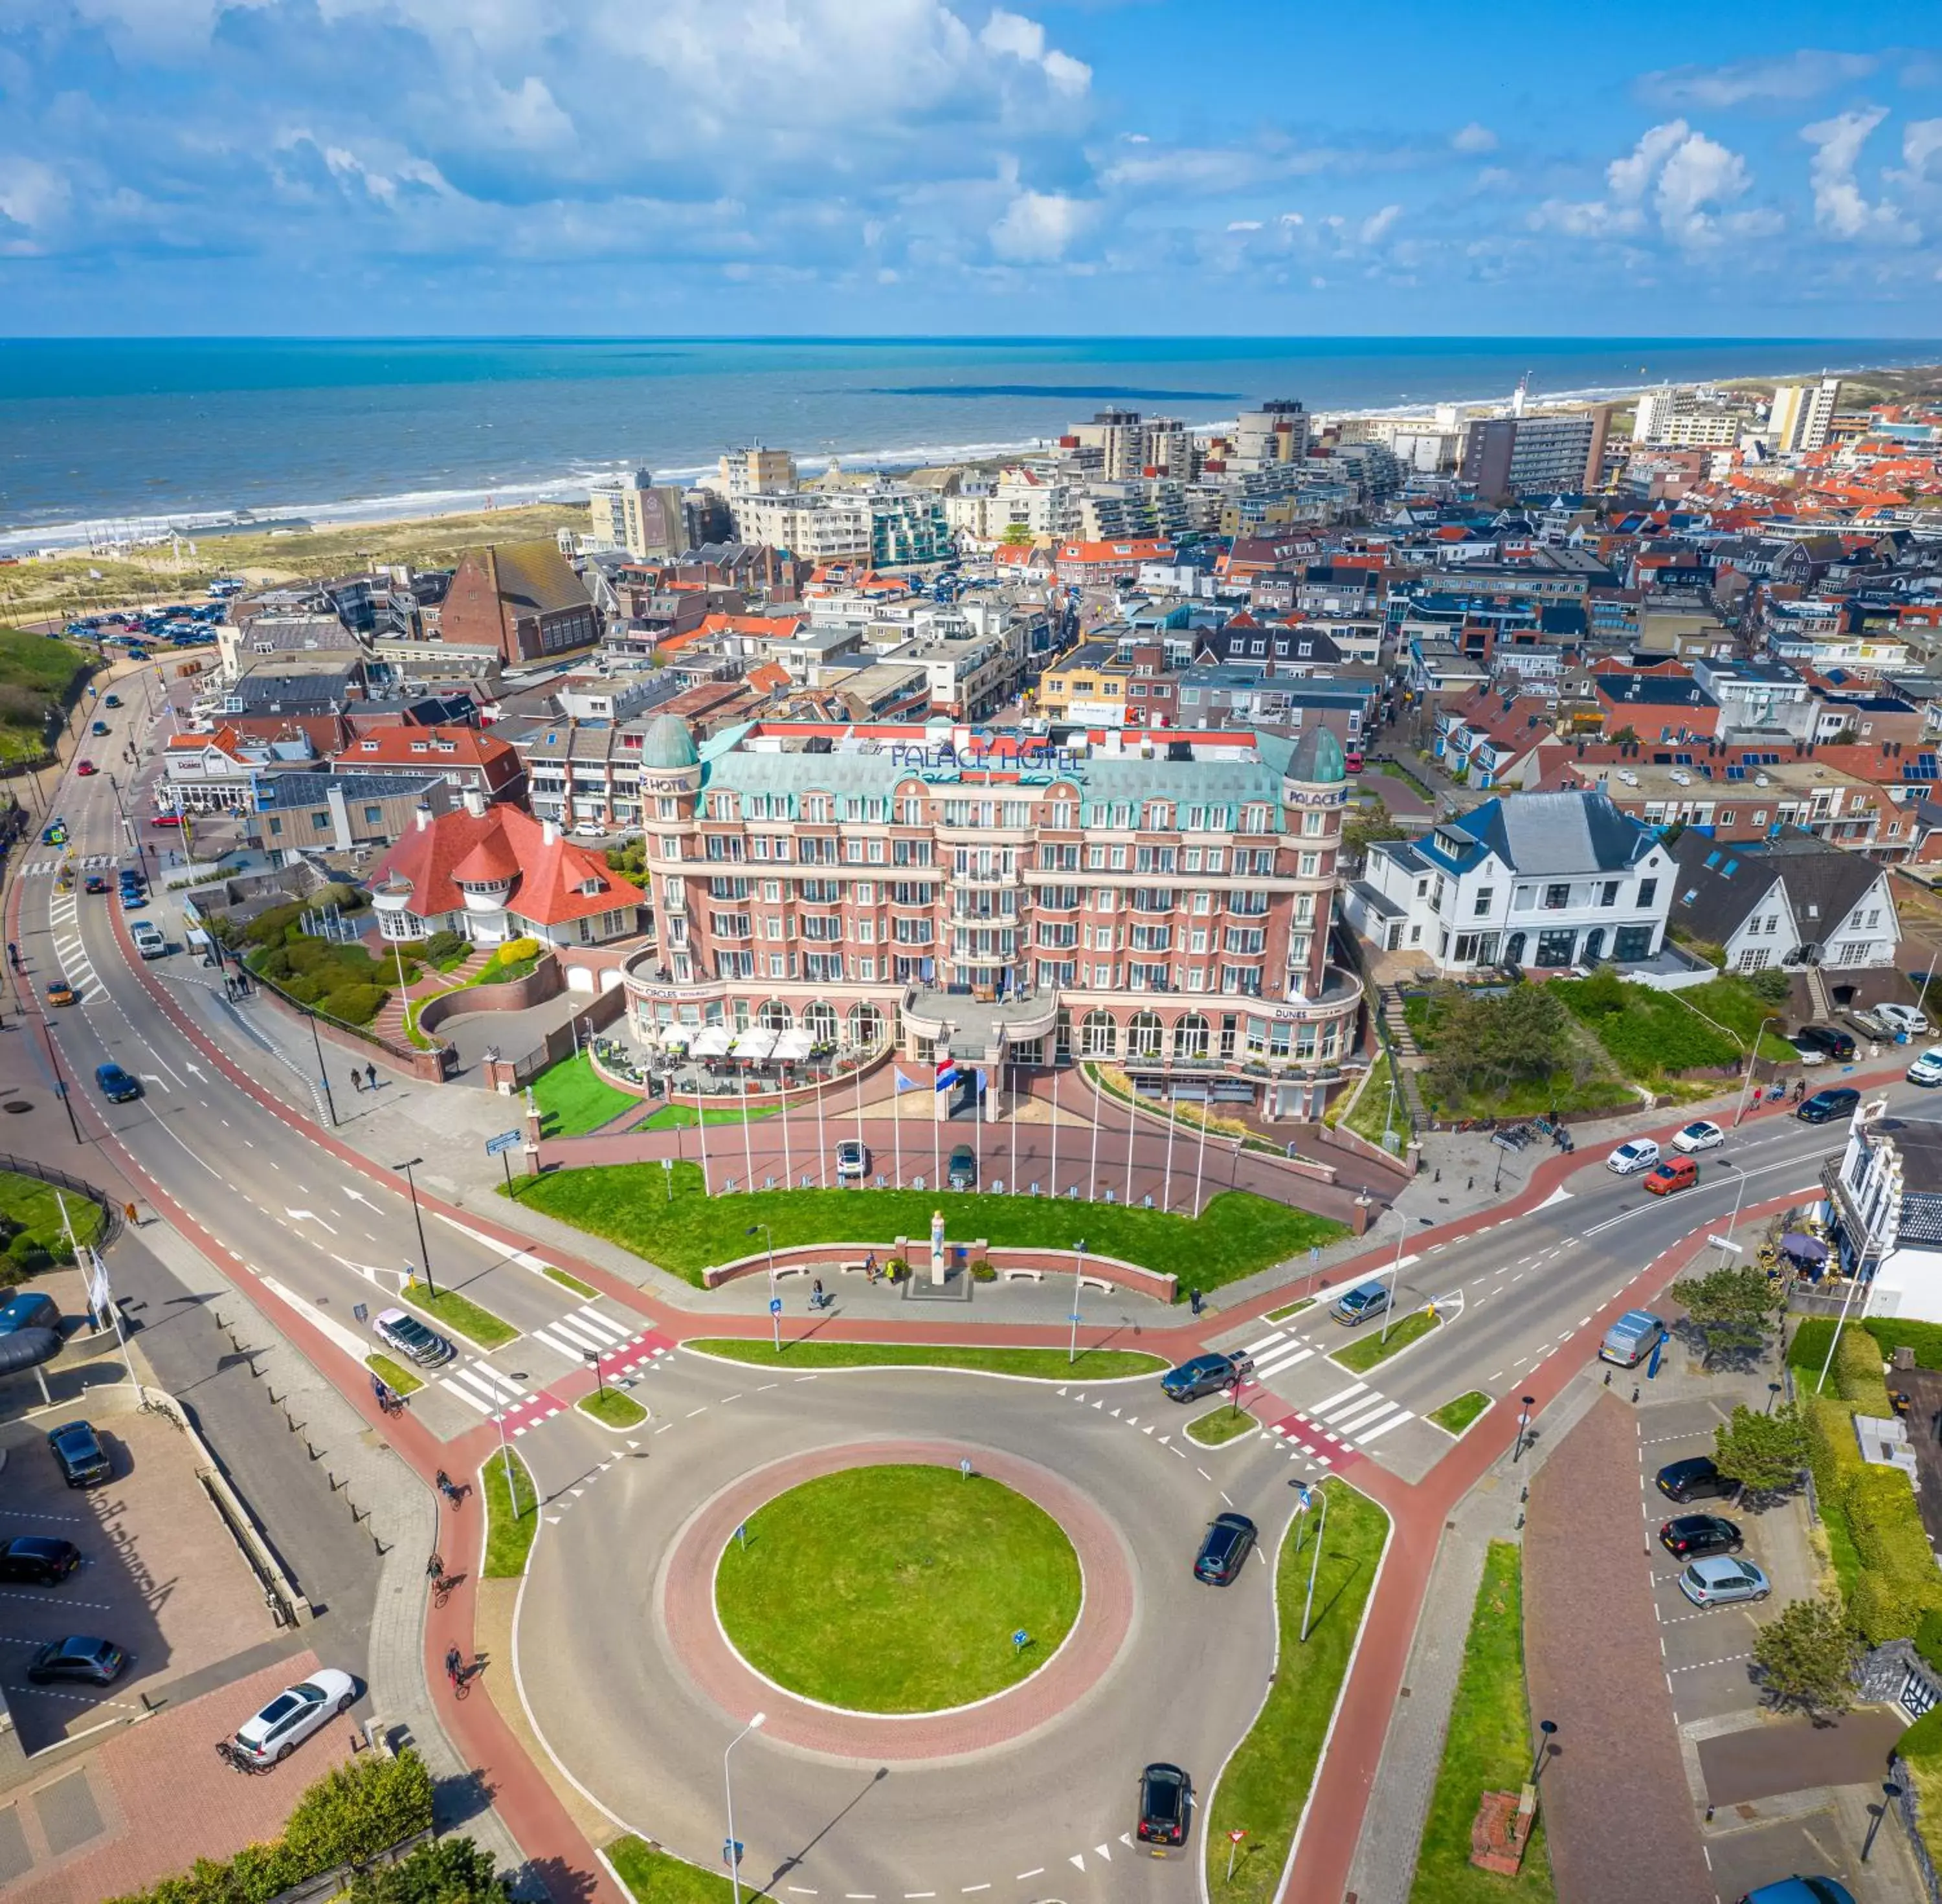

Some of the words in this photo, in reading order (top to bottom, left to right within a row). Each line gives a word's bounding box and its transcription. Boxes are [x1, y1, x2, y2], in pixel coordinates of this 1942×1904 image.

[892, 746, 989, 769] PALACE
[1001, 747, 1084, 770] HOTEL
[1290, 790, 1337, 807] PALACE
[646, 989, 678, 999] CIRCLES
[1276, 1009, 1307, 1018] DUNES
